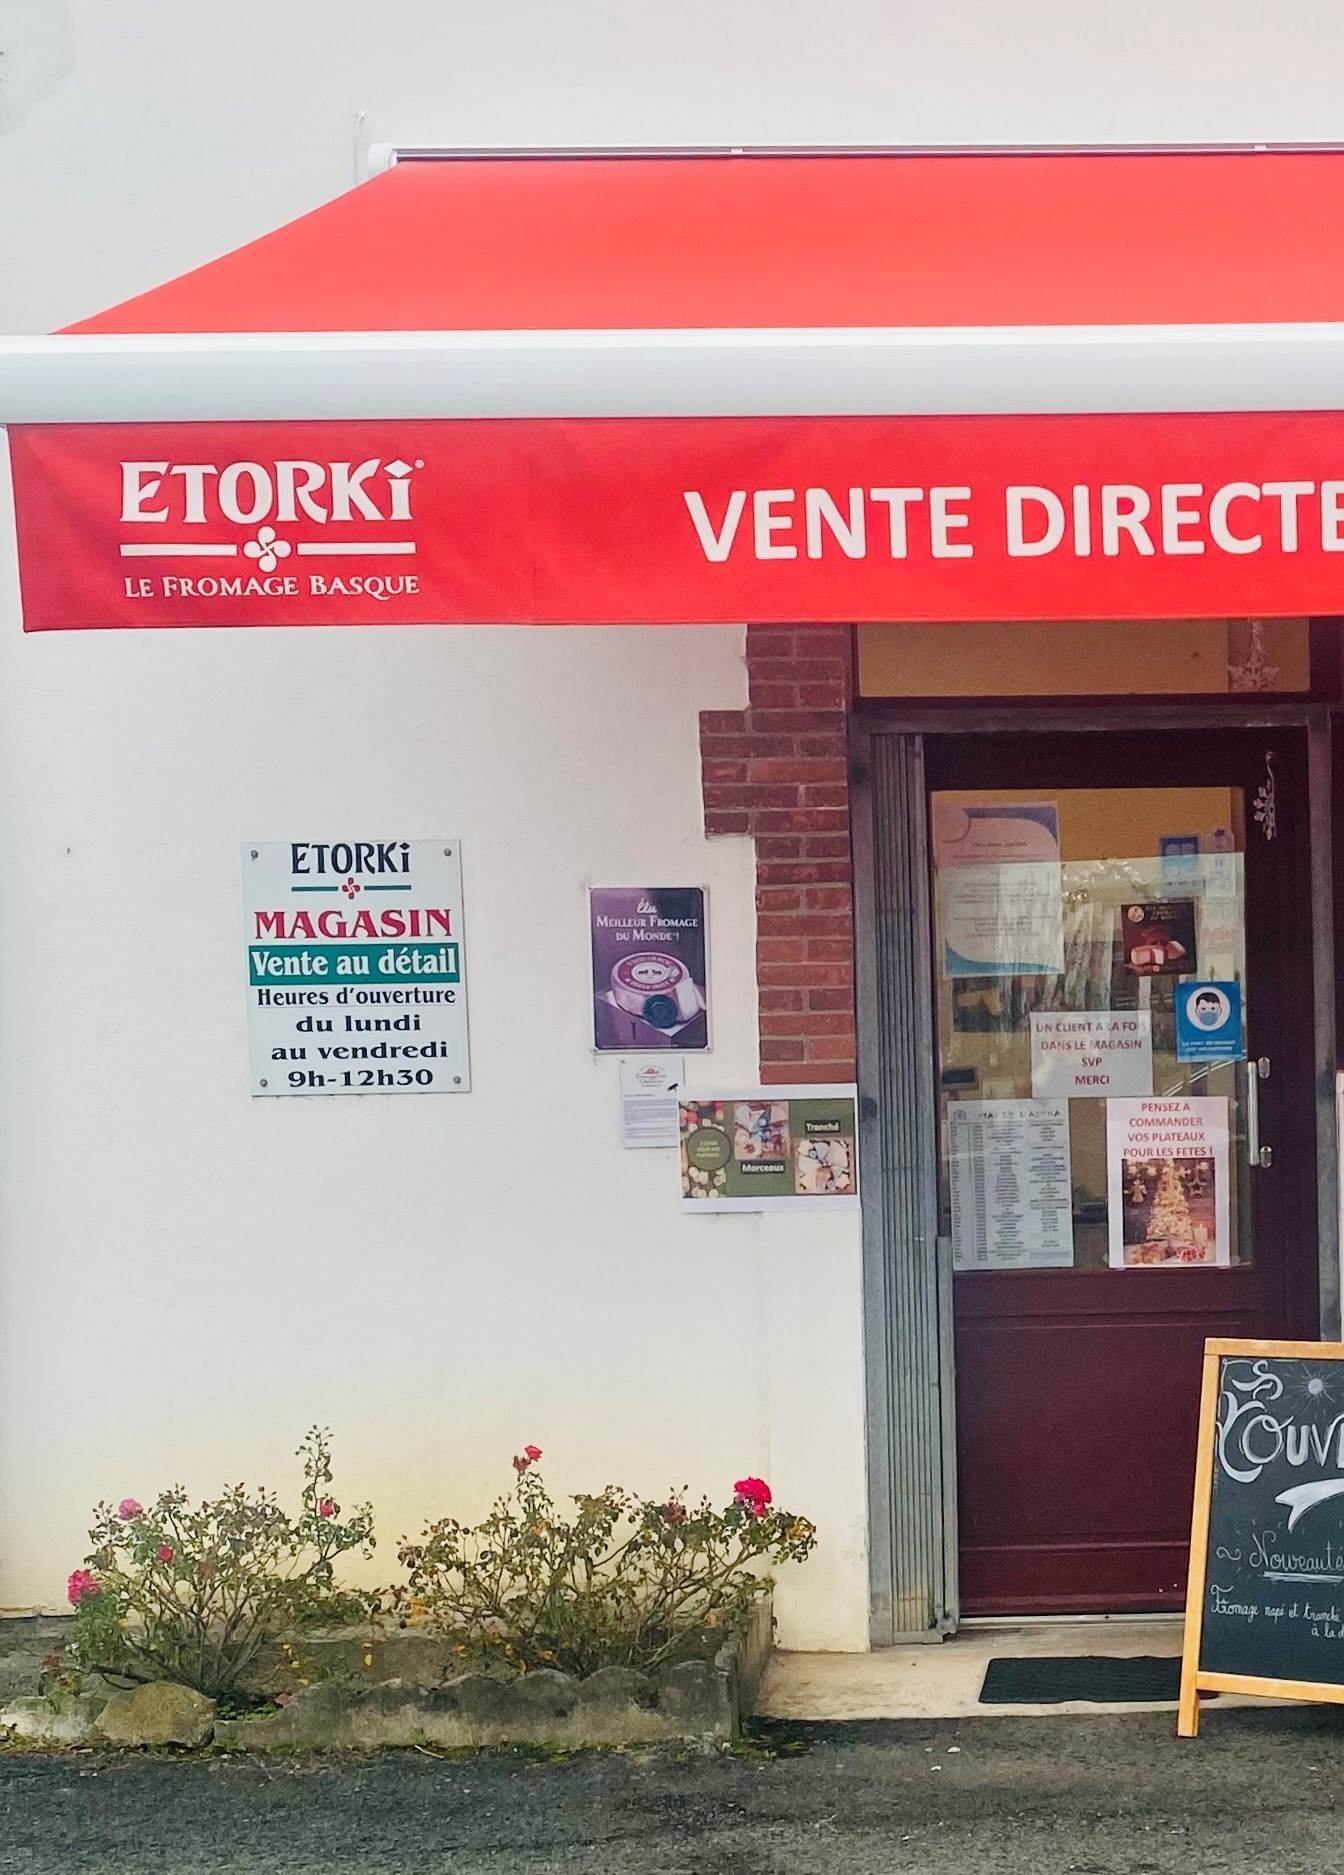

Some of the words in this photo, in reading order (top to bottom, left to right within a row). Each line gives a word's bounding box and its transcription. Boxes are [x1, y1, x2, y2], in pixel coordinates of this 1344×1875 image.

[683, 487, 974, 562] VENTE
[125, 577, 151, 598] LE
[163, 576, 299, 597] FROMAGE
[310, 575, 420, 600] BASQUE
[254, 909, 452, 940] MAGASIN
[649, 915, 698, 927] FROMAGE
[251, 951, 328, 976] Vente
[337, 955, 370, 975] au
[378, 947, 456, 975] détail
[257, 989, 329, 1006] Heures
[336, 987, 456, 1006] d'ouverture
[296, 1016, 333, 1033] du
[345, 1014, 421, 1032] lundi
[1036, 1022, 1052, 1032] UN
[1055, 1022, 1092, 1032] CLIENT
[1123, 1021, 1146, 1031] FOS
[271, 1046, 307, 1060] au
[318, 1041, 448, 1059] vendredi
[1041, 1041, 1071, 1051] DANS
[1075, 1040, 1086, 1050] LE
[1090, 1040, 1142, 1050] MAGASIN
[1081, 1057, 1102, 1067] SVP
[288, 1069, 434, 1087] 9h-12h30
[1075, 1075, 1110, 1085] MERCI
[1141, 1102, 1180, 1111] PENSEZ
[1183, 1102, 1190, 1111] A
[1129, 1117, 1203, 1127] COMMANDER
[1128, 1132, 1149, 1141] VOS
[1152, 1132, 1205, 1141] PLATEAUX
[1123, 1147, 1154, 1157] POUR
[1156, 1147, 1173, 1156] LES
[1176, 1146, 1206, 1156] FETES
[742, 1163, 784, 1173] Morceaux
[1288, 1602, 1299, 1618] et
[1324, 1623, 1335, 1637] la
